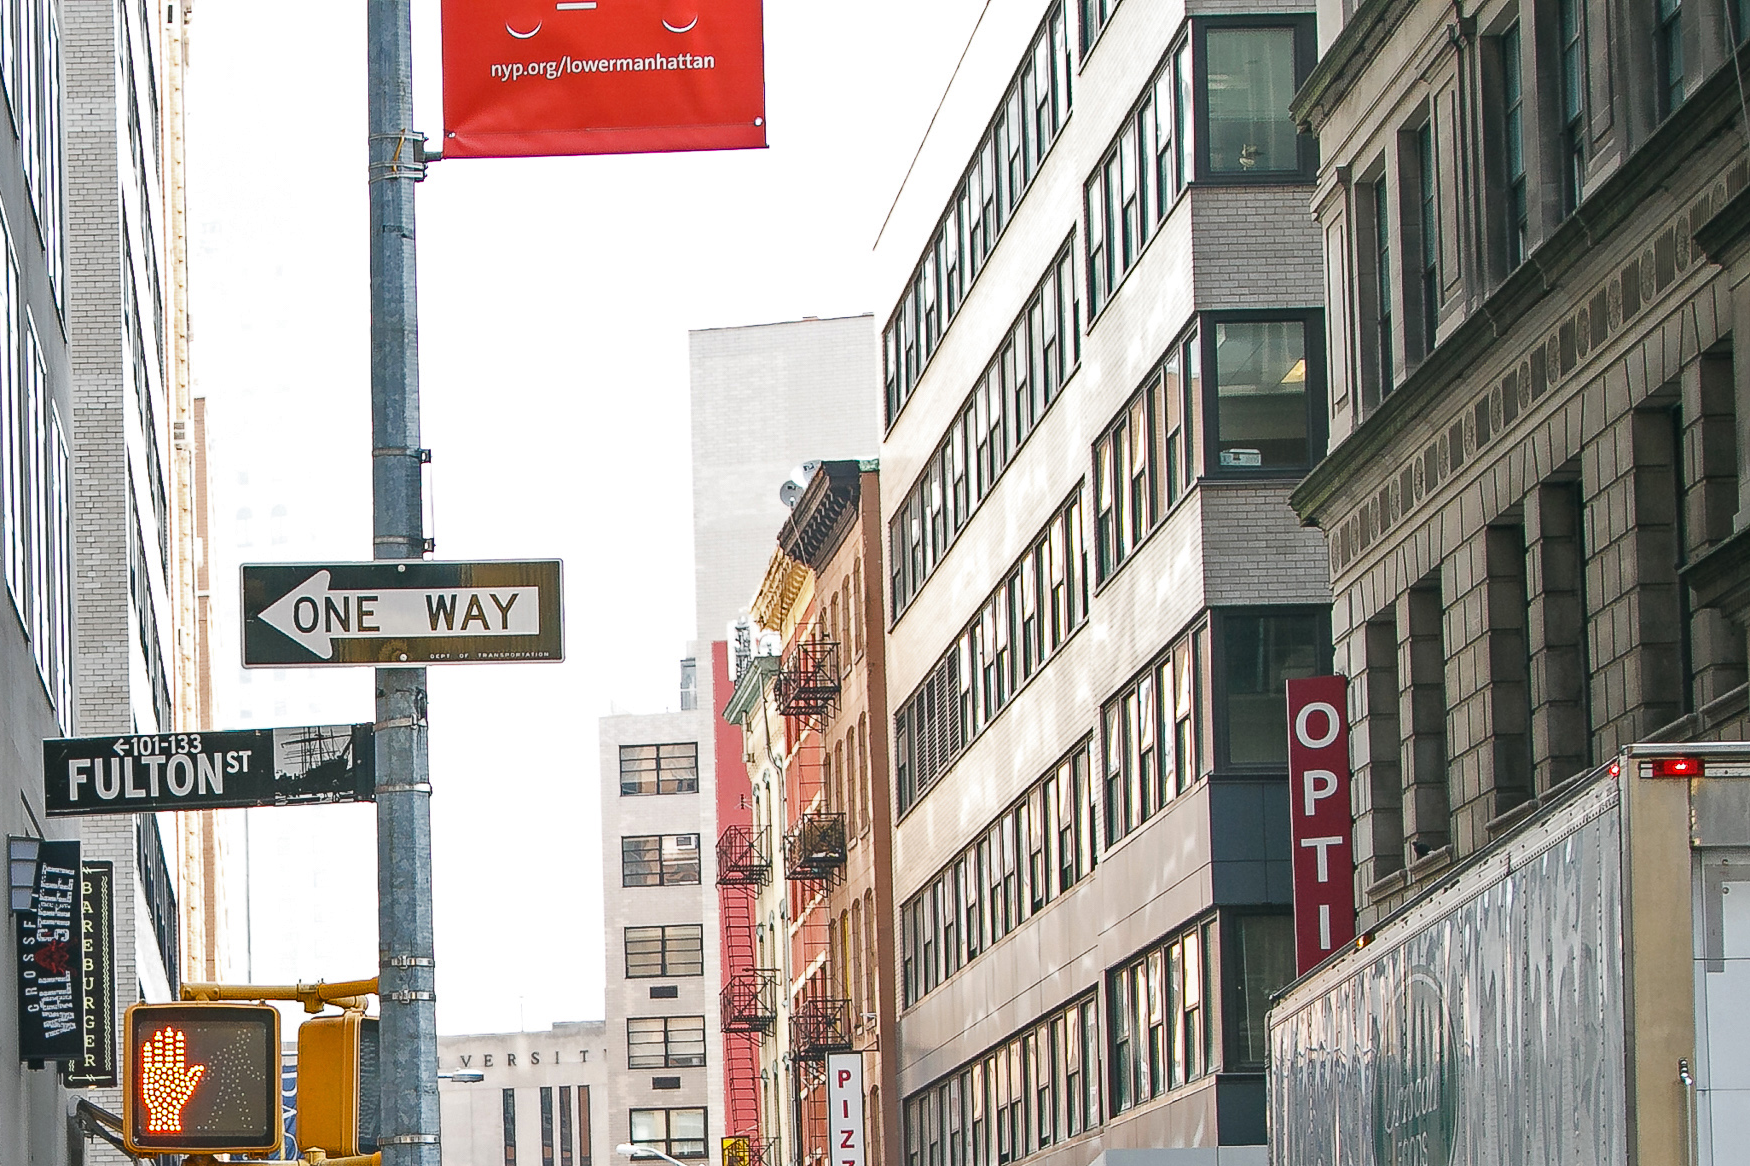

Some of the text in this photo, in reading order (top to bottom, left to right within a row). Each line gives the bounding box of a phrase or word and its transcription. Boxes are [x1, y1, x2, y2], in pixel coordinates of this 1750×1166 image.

[490, 52, 715, 82] nyp.org/lowermanhattan
[293, 592, 520, 634] ONE WAY
[131, 734, 202, 757] 101-133
[68, 750, 252, 801] FULTON ST
[23, 893, 39, 1012] CROSSF
[36, 862, 77, 1039] WALL STREET
[82, 881, 96, 1067] BAREBURGER
[437, 1049, 607, 1069] IVERSIT
